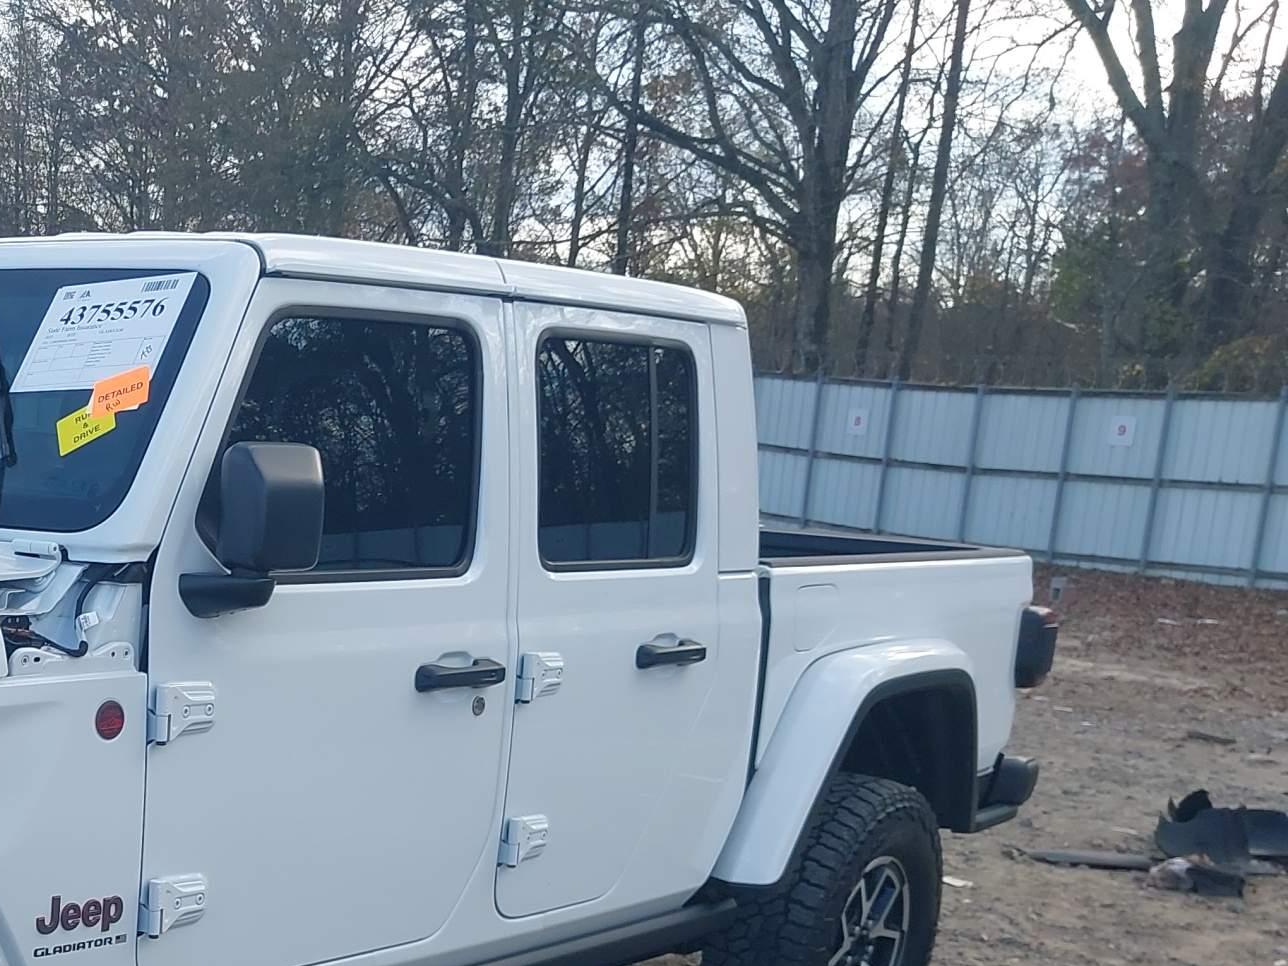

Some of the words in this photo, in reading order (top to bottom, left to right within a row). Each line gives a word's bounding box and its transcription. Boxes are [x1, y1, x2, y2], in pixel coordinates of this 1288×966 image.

[59, 297, 169, 325] 43755576
[98, 381, 143, 403] DETAILED
[74, 413, 91, 425] RU
[1117, 424, 1127, 436] 9
[73, 424, 101, 444] DRIVE
[35, 895, 124, 935] Jeep
[33, 936, 113, 958] GLADIATOR
